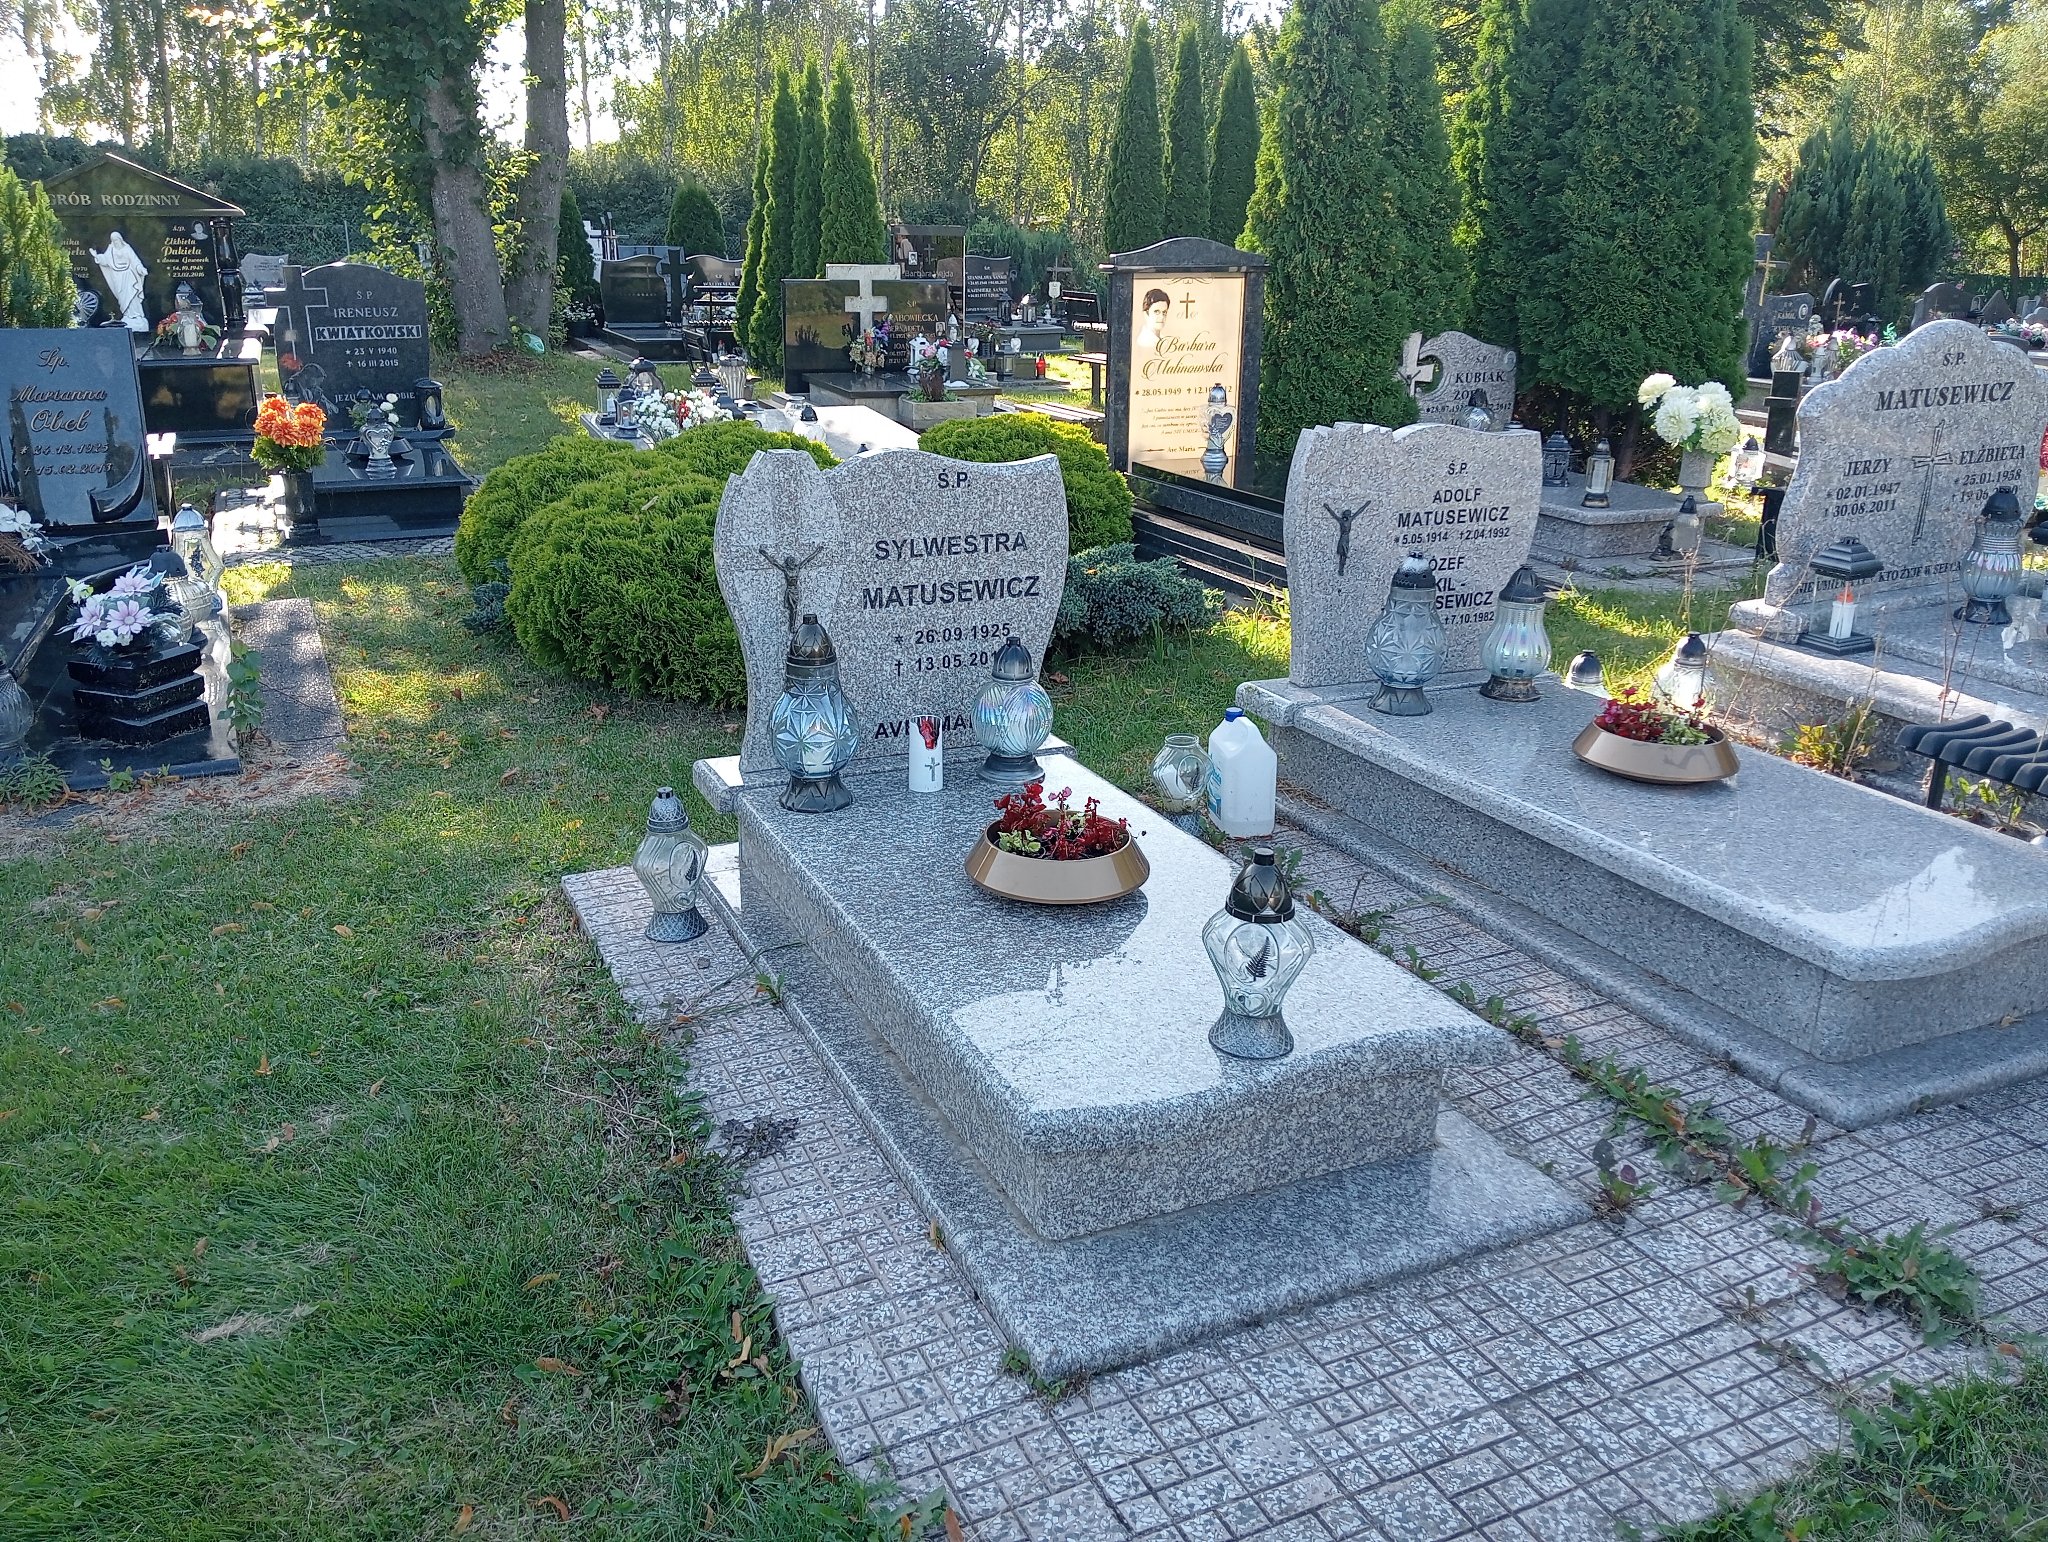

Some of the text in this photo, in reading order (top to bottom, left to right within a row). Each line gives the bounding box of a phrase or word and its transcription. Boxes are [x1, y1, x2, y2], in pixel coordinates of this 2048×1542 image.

[101, 194, 181, 206] RODZINNY
[333, 307, 399, 318] IRENEUSZ
[315, 325, 422, 340] KWIATKOWSKI
[1155, 331, 1217, 358] Barbara
[1141, 352, 1229, 381] Malinowska
[1455, 371, 1505, 383] KUBIAK
[10, 385, 108, 402] Marianna
[1141, 387, 1182, 397] 28.05.1949
[1875, 382, 2015, 411] MATUSEWICZ
[31, 409, 91, 432] Obel
[1957, 445, 2025, 465] ELŻBIETA
[1843, 458, 1893, 477] JERZY
[1963, 469, 2021, 486] 25.01.1958
[1433, 488, 1482, 503] ADOLF
[1836, 482, 1901, 500] 02.01.1947
[1398, 506, 1510, 528] MATUSEWICZ
[1833, 500, 1896, 518] 30.08.2011
[874, 532, 1029, 561] SYLWESTRA
[1402, 532, 1449, 544] 5.05.1914
[1428, 555, 1465, 571] ÓZEF
[861, 575, 1041, 610] MATUSEWICZ
[1436, 591, 1493, 609] SEWICZ
[915, 623, 1011, 645] 26.09.1925
